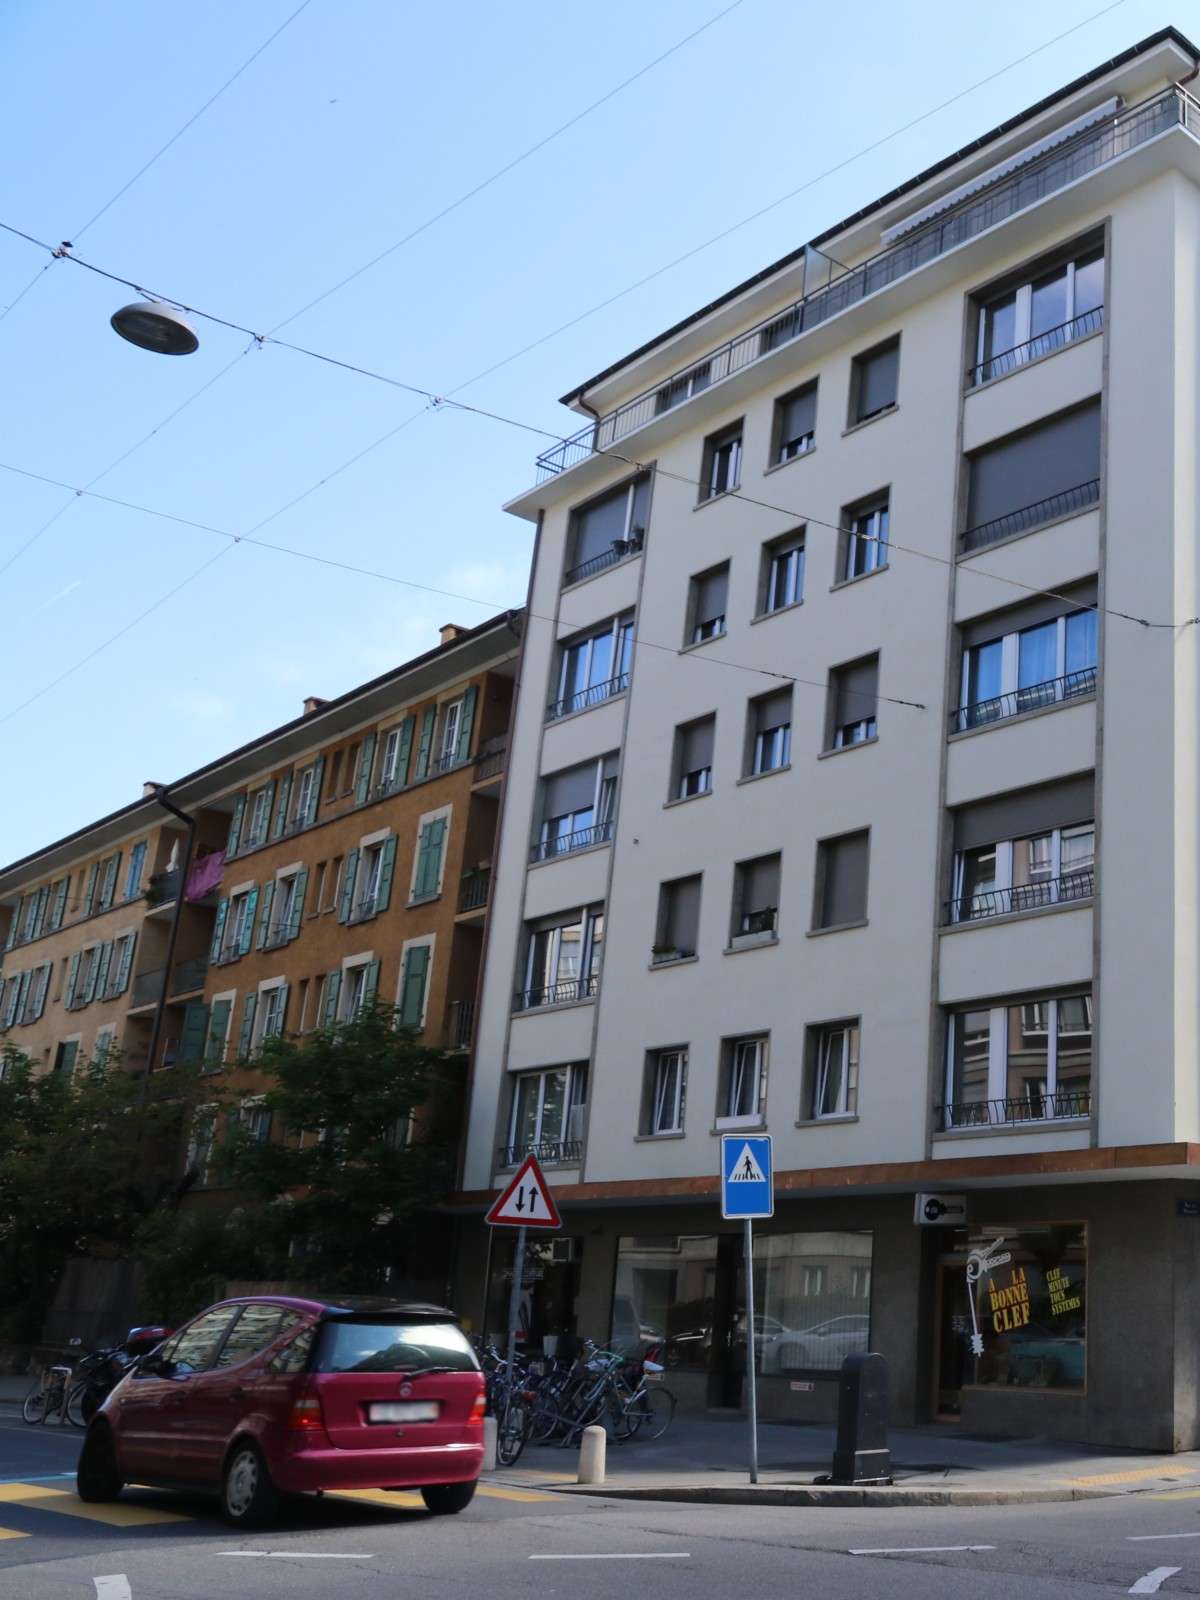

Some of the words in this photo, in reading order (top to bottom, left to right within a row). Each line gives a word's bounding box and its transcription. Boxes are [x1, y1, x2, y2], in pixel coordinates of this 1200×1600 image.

[989, 1278, 996, 1292] A
[1011, 1267, 1026, 1285] LA
[989, 1283, 1029, 1311] BONNE
[993, 1302, 1030, 1333] CLEF
